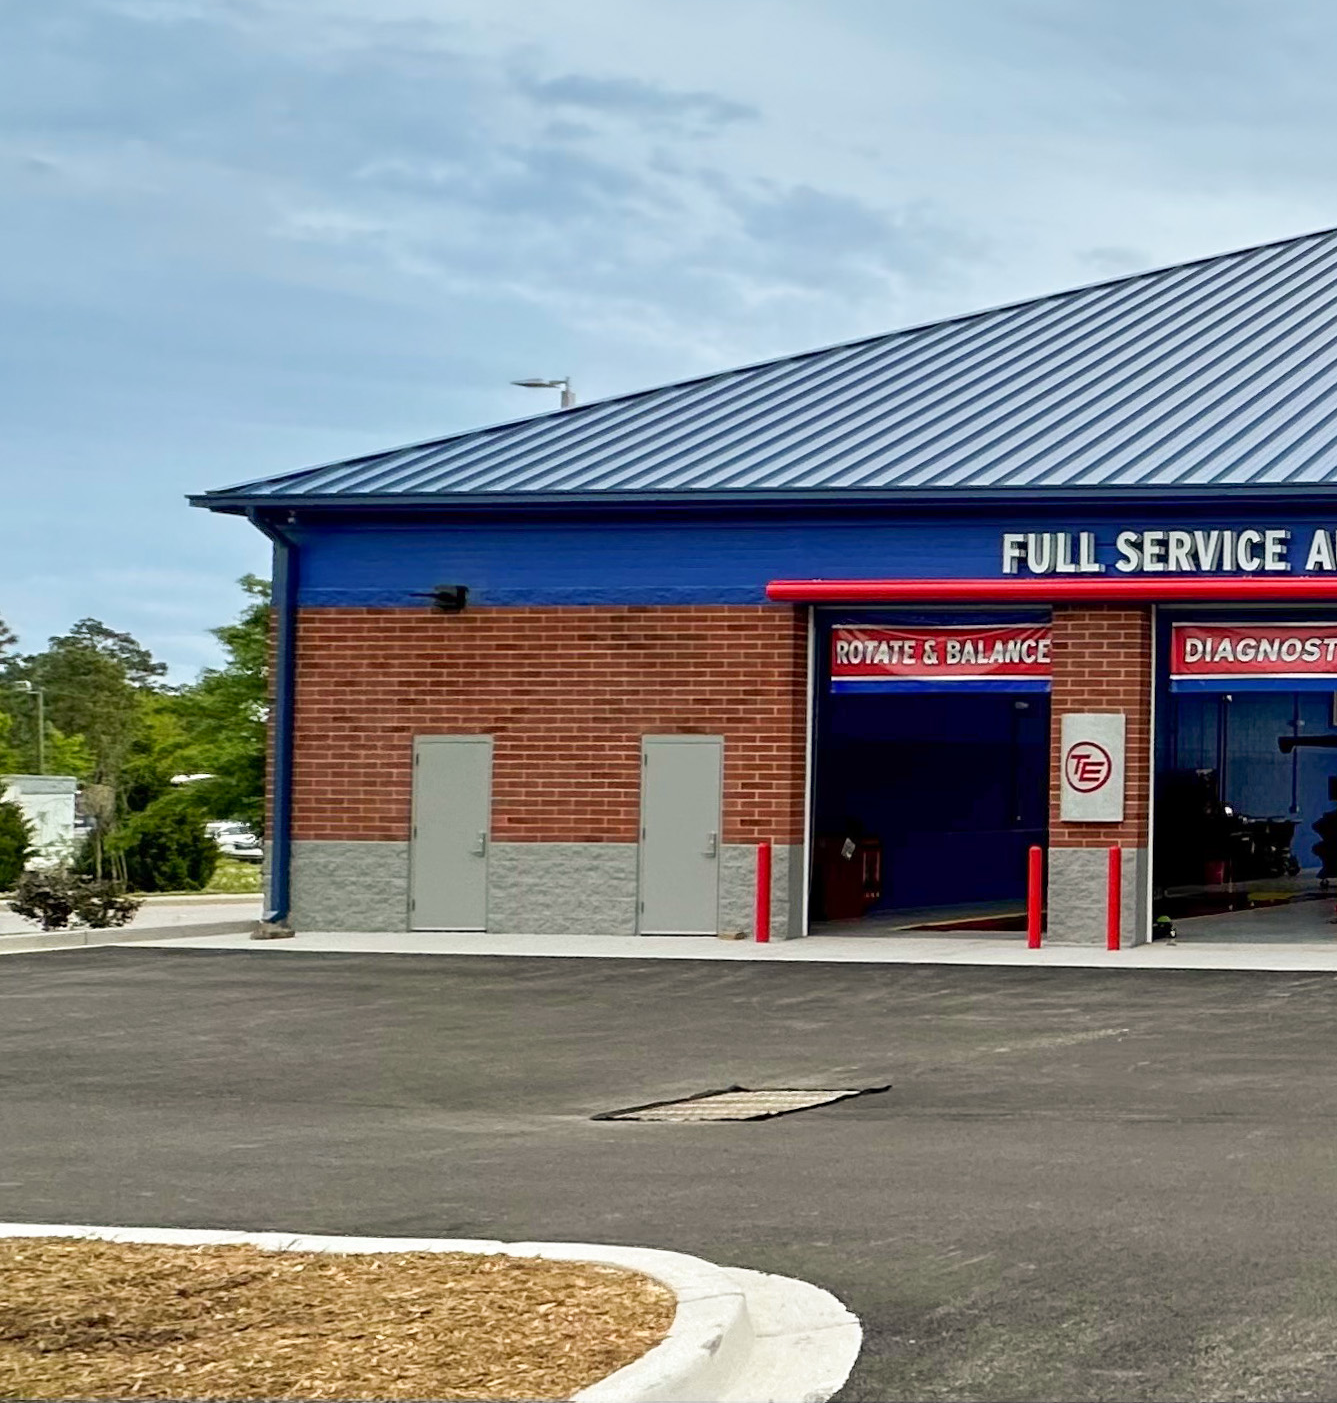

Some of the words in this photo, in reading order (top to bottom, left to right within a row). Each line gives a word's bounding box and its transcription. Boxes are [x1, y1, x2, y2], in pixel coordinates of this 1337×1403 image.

[1002, 531, 1106, 574] FULL
[1115, 530, 1292, 573] SERVICE
[836, 639, 917, 665] ROTATE
[922, 639, 940, 665] &
[946, 638, 1051, 665] BALANCE
[1070, 753, 1106, 783] TE
